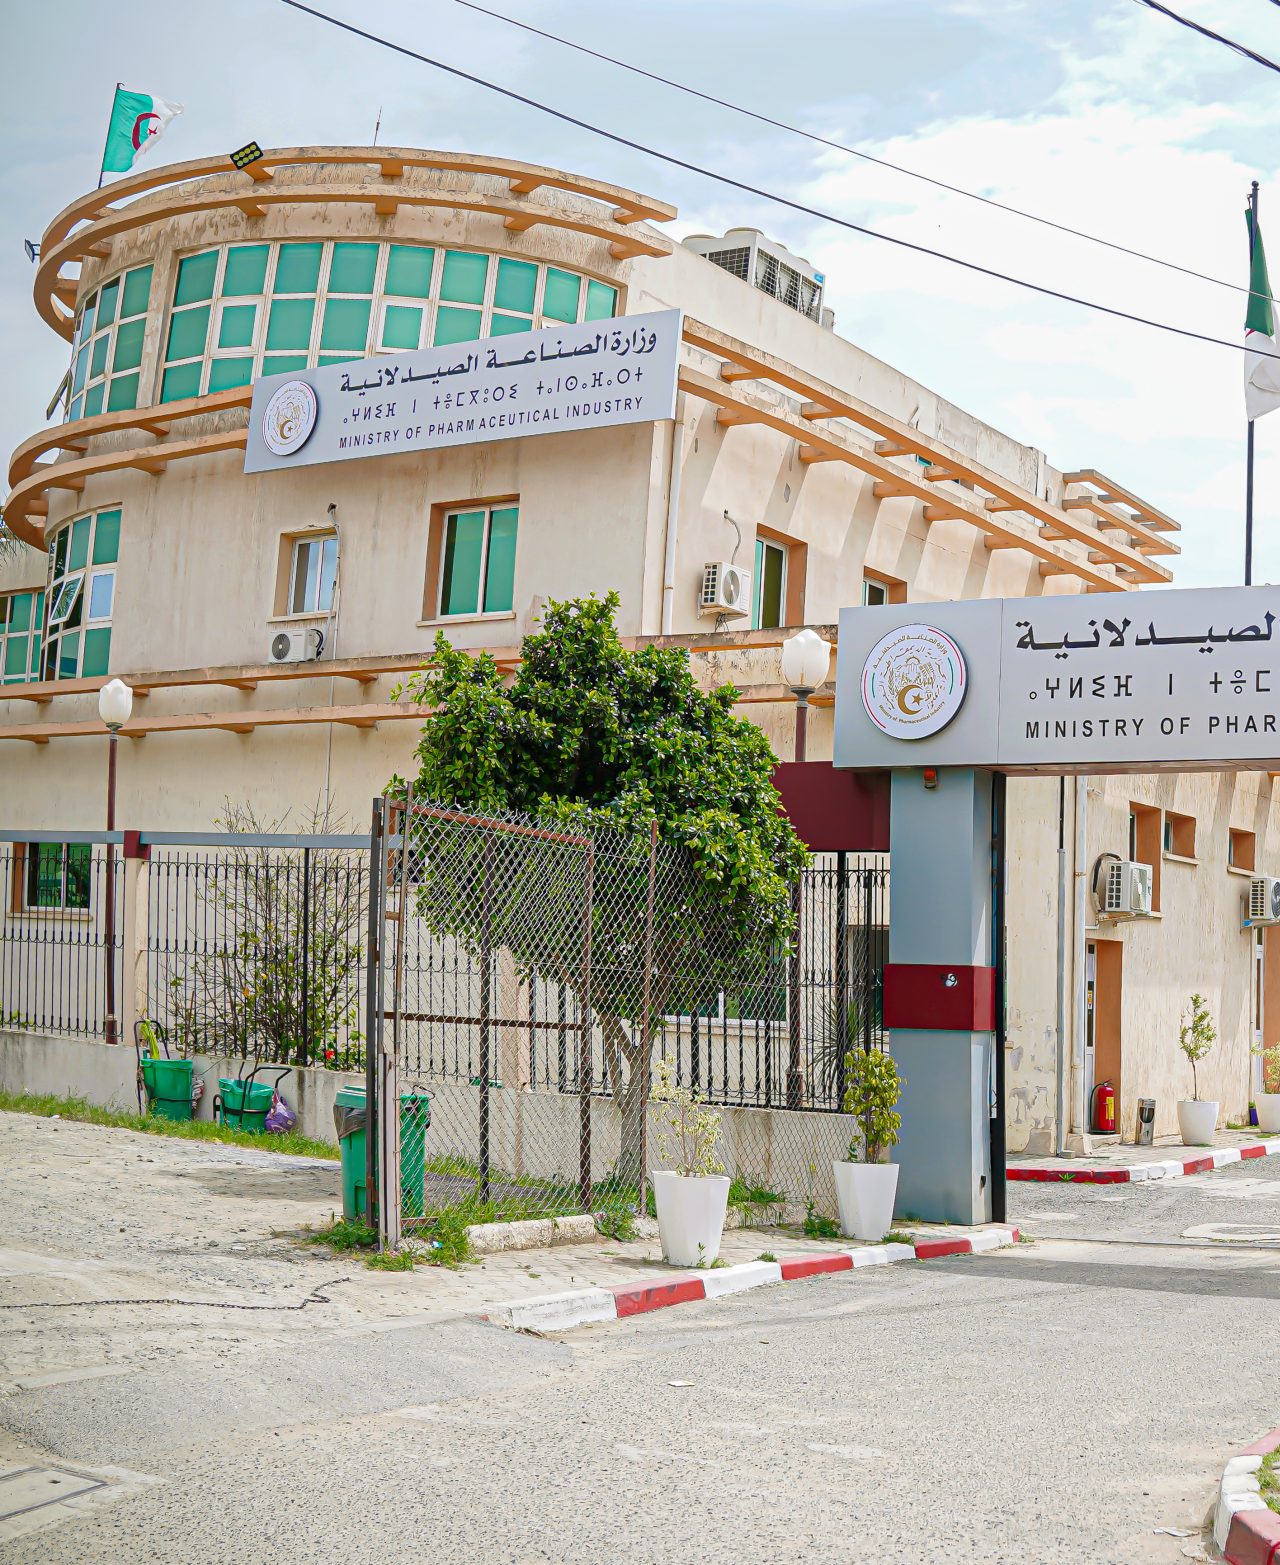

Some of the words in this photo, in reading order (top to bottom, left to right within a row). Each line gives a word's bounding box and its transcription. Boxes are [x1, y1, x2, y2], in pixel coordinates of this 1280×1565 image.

[486, 332, 607, 368] الصناعة
[611, 328, 656, 356] وزارة
[338, 352, 479, 397] الصيدلانية
[338, 427, 402, 450] MINISTRY
[406, 426, 421, 439] OF
[427, 406, 562, 438] PHARMACEUTICAL
[565, 395, 644, 418] INDUSTRY
[1026, 719, 1143, 738] MINISTRY
[1161, 717, 1190, 735] OF
